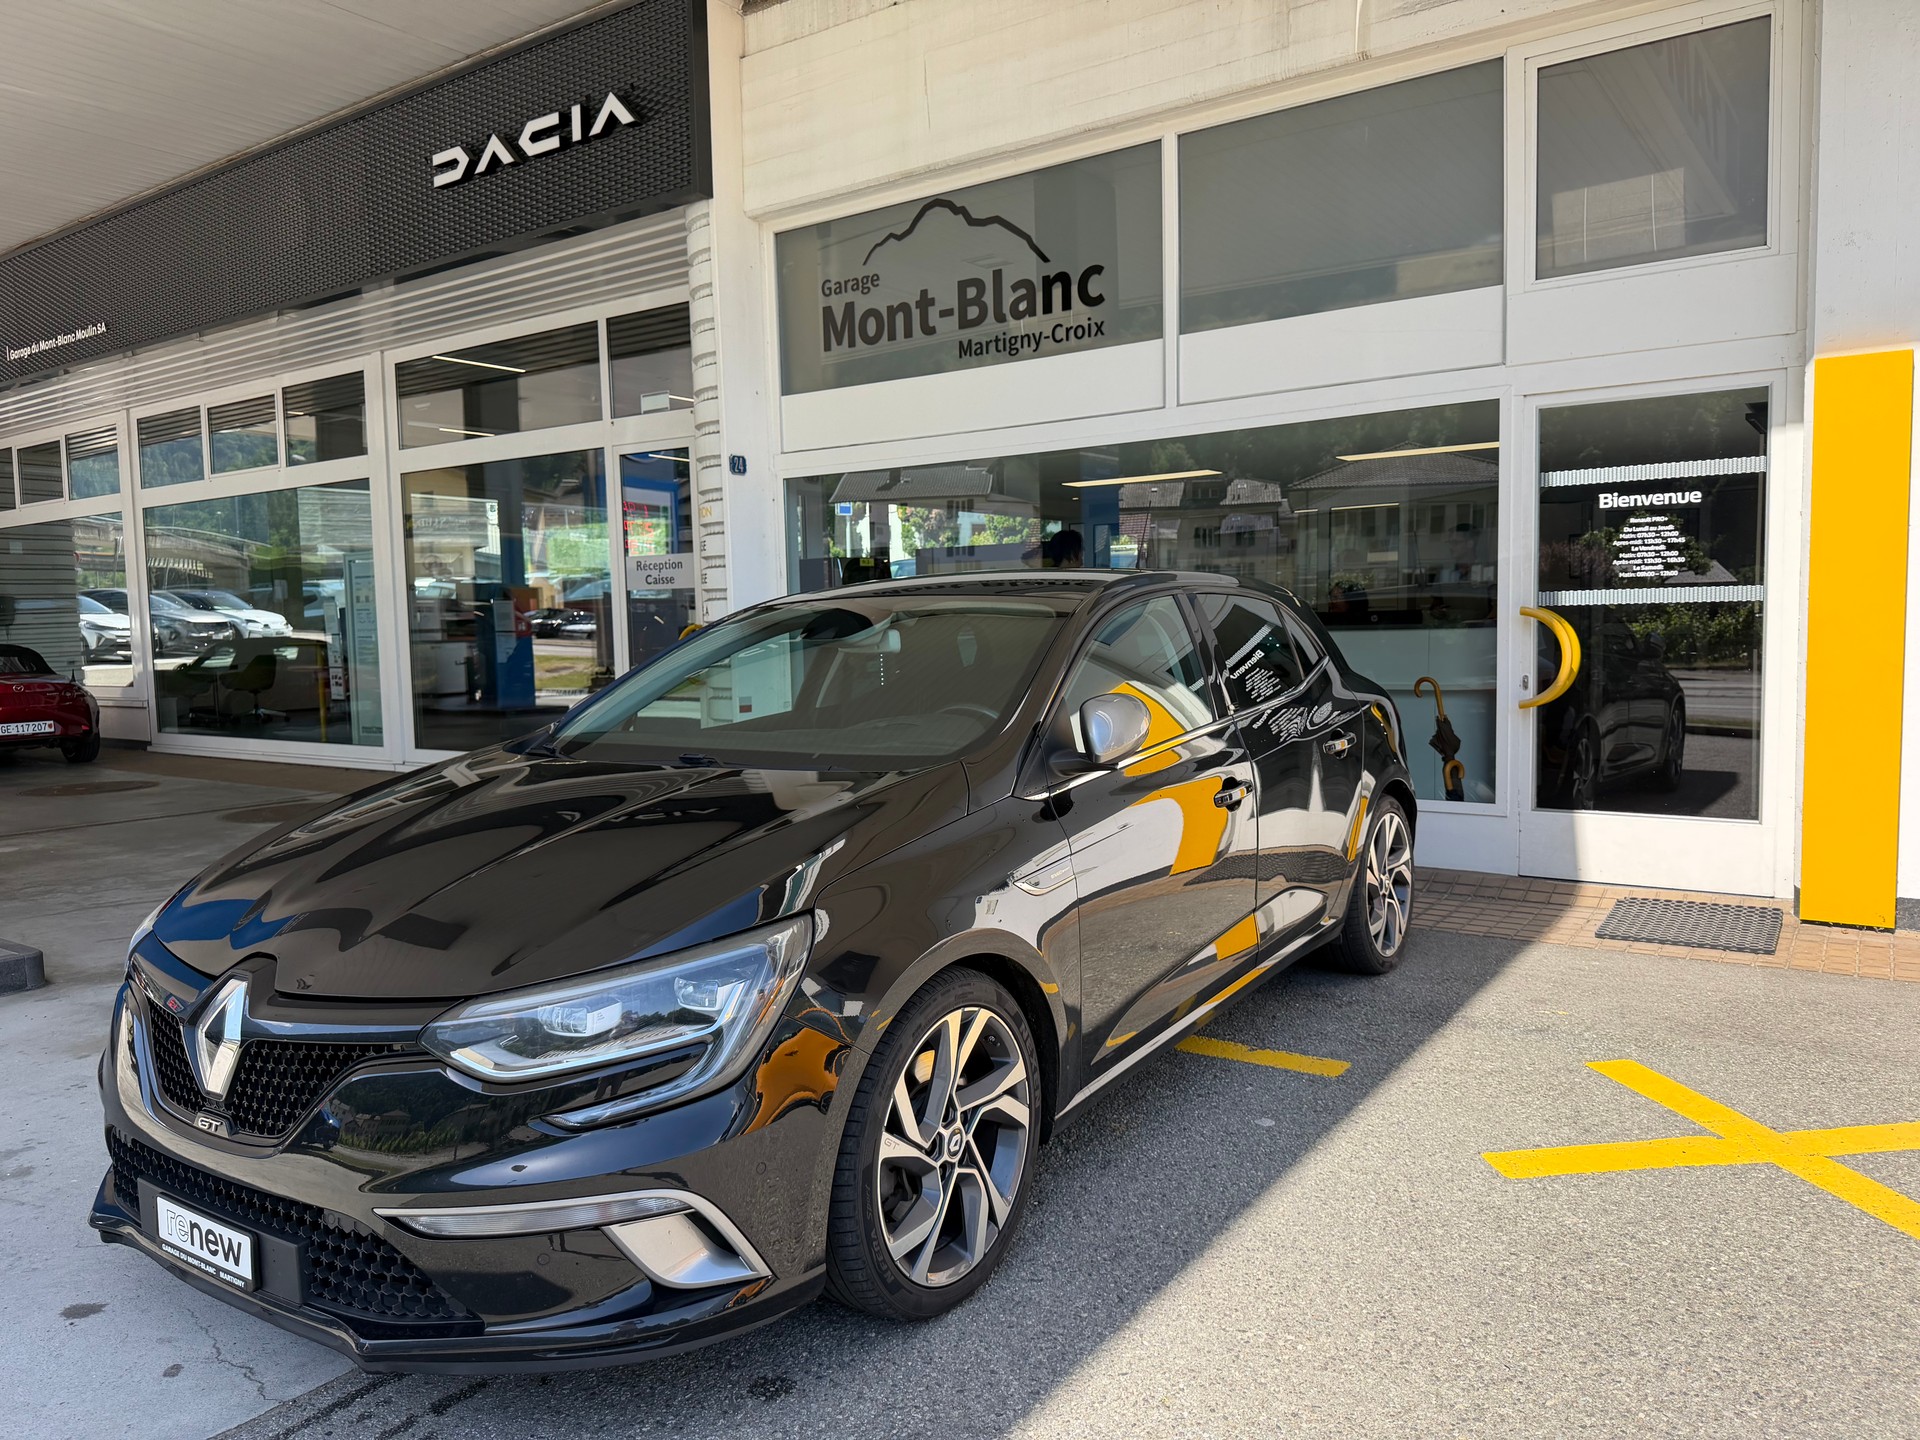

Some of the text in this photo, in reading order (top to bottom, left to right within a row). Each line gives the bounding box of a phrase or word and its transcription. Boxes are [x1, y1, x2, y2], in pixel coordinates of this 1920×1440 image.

[432, 91, 636, 188] DACIA
[821, 273, 880, 298] Garage
[822, 264, 1106, 352] Mont-Blanc
[10, 322, 106, 359] Garage du Mont-Blanc Moulin SA
[958, 317, 1105, 359] Martigny-Croix
[733, 457, 745, 473] 24
[1598, 490, 1702, 509] Bienvenue
[636, 559, 683, 574] Réception
[645, 574, 675, 585] Caisse
[198, 1116, 222, 1133] GT
[884, 1137, 900, 1150] GT
[166, 1208, 242, 1268] renew
[161, 1243, 245, 1288] GARAGE DU MONT-BLANC MARTIGNY
